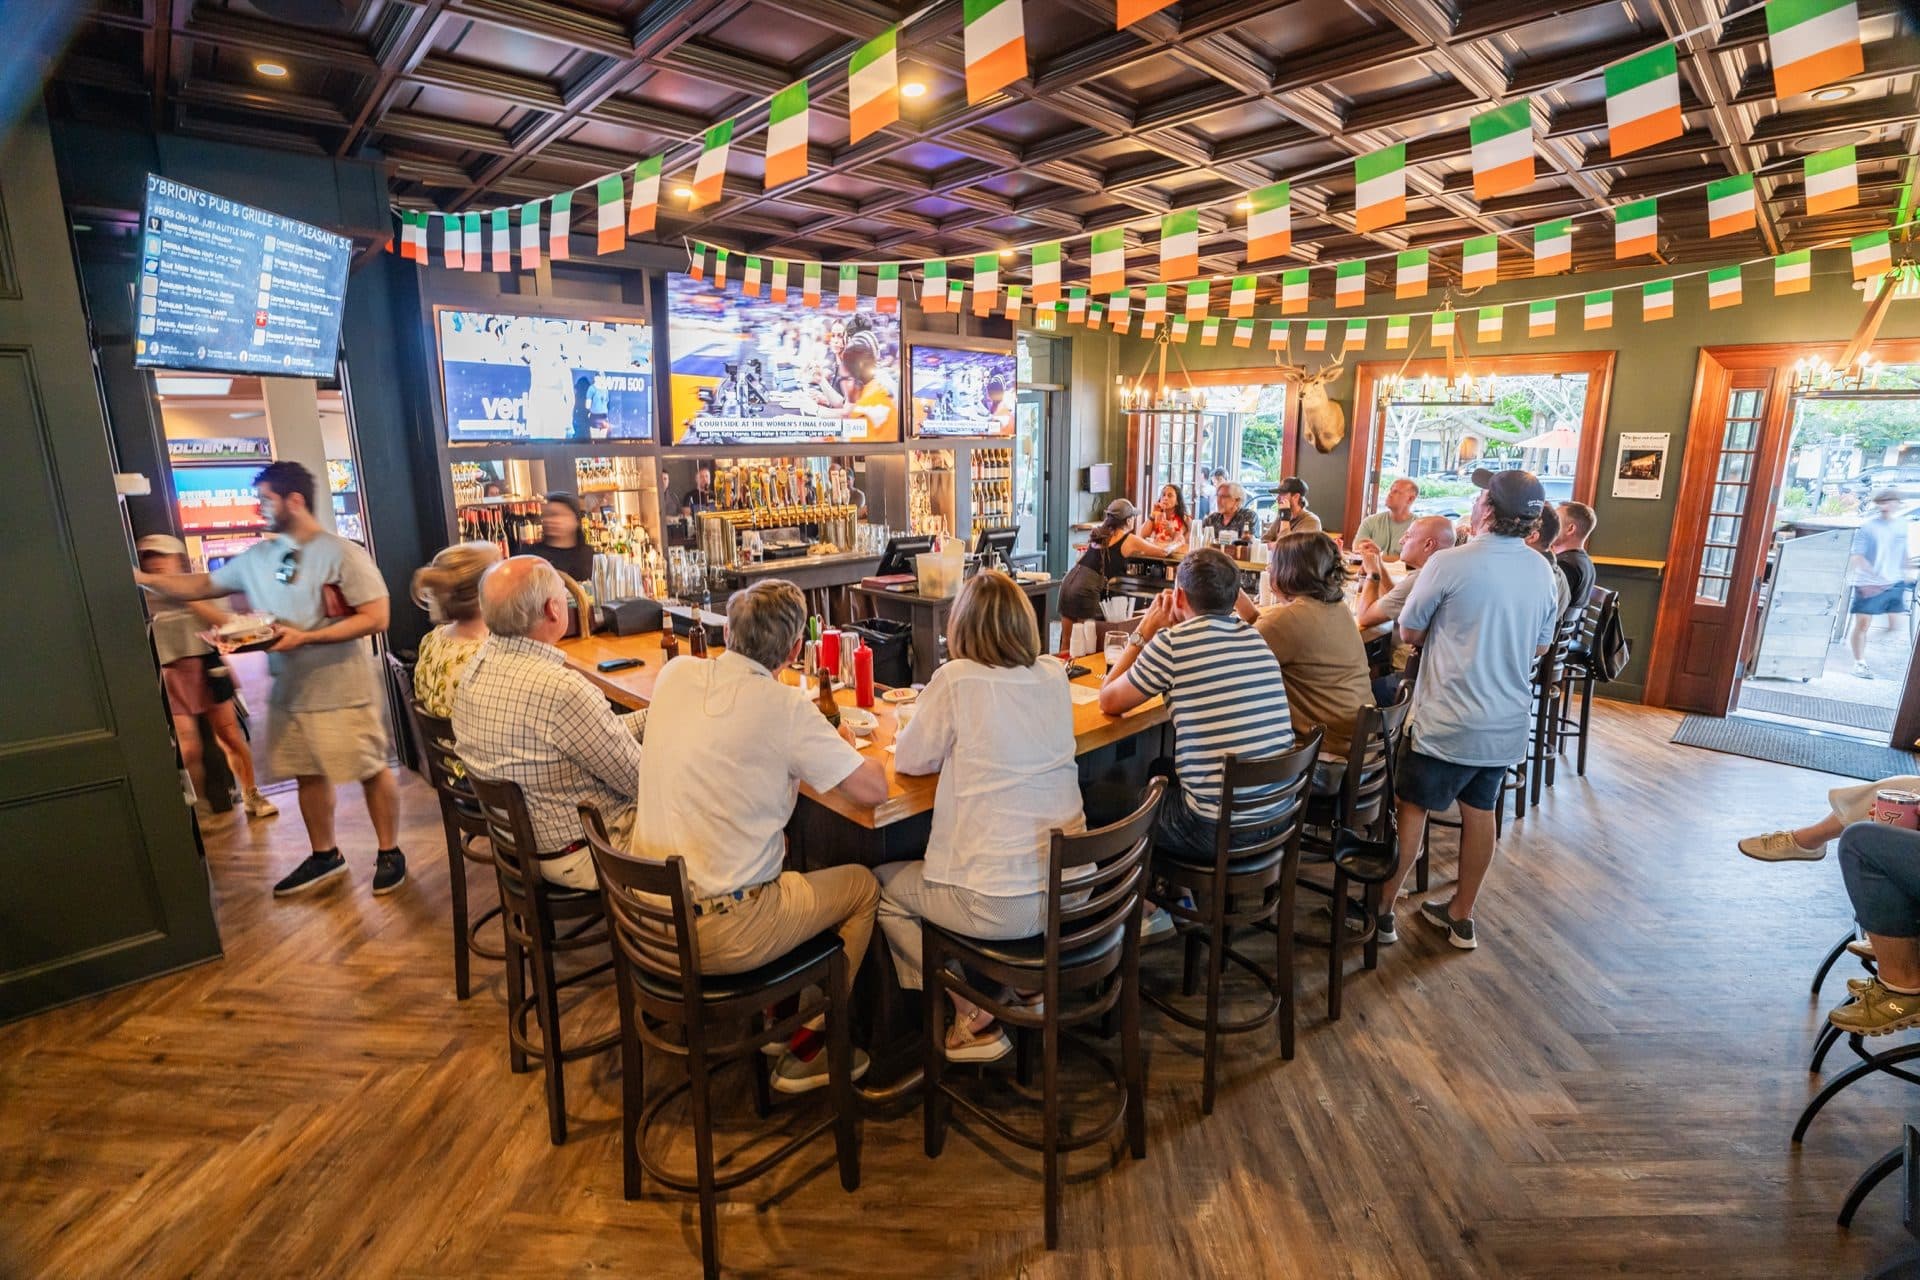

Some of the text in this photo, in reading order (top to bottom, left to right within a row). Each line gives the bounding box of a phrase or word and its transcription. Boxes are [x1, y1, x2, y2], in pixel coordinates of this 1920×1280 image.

[148, 177, 206, 207] O'BRION'S
[209, 196, 230, 214] PUB
[232, 203, 239, 217] &
[241, 207, 274, 228] GRILLE
[281, 219, 296, 234] MT.
[627, 376, 645, 392] 500
